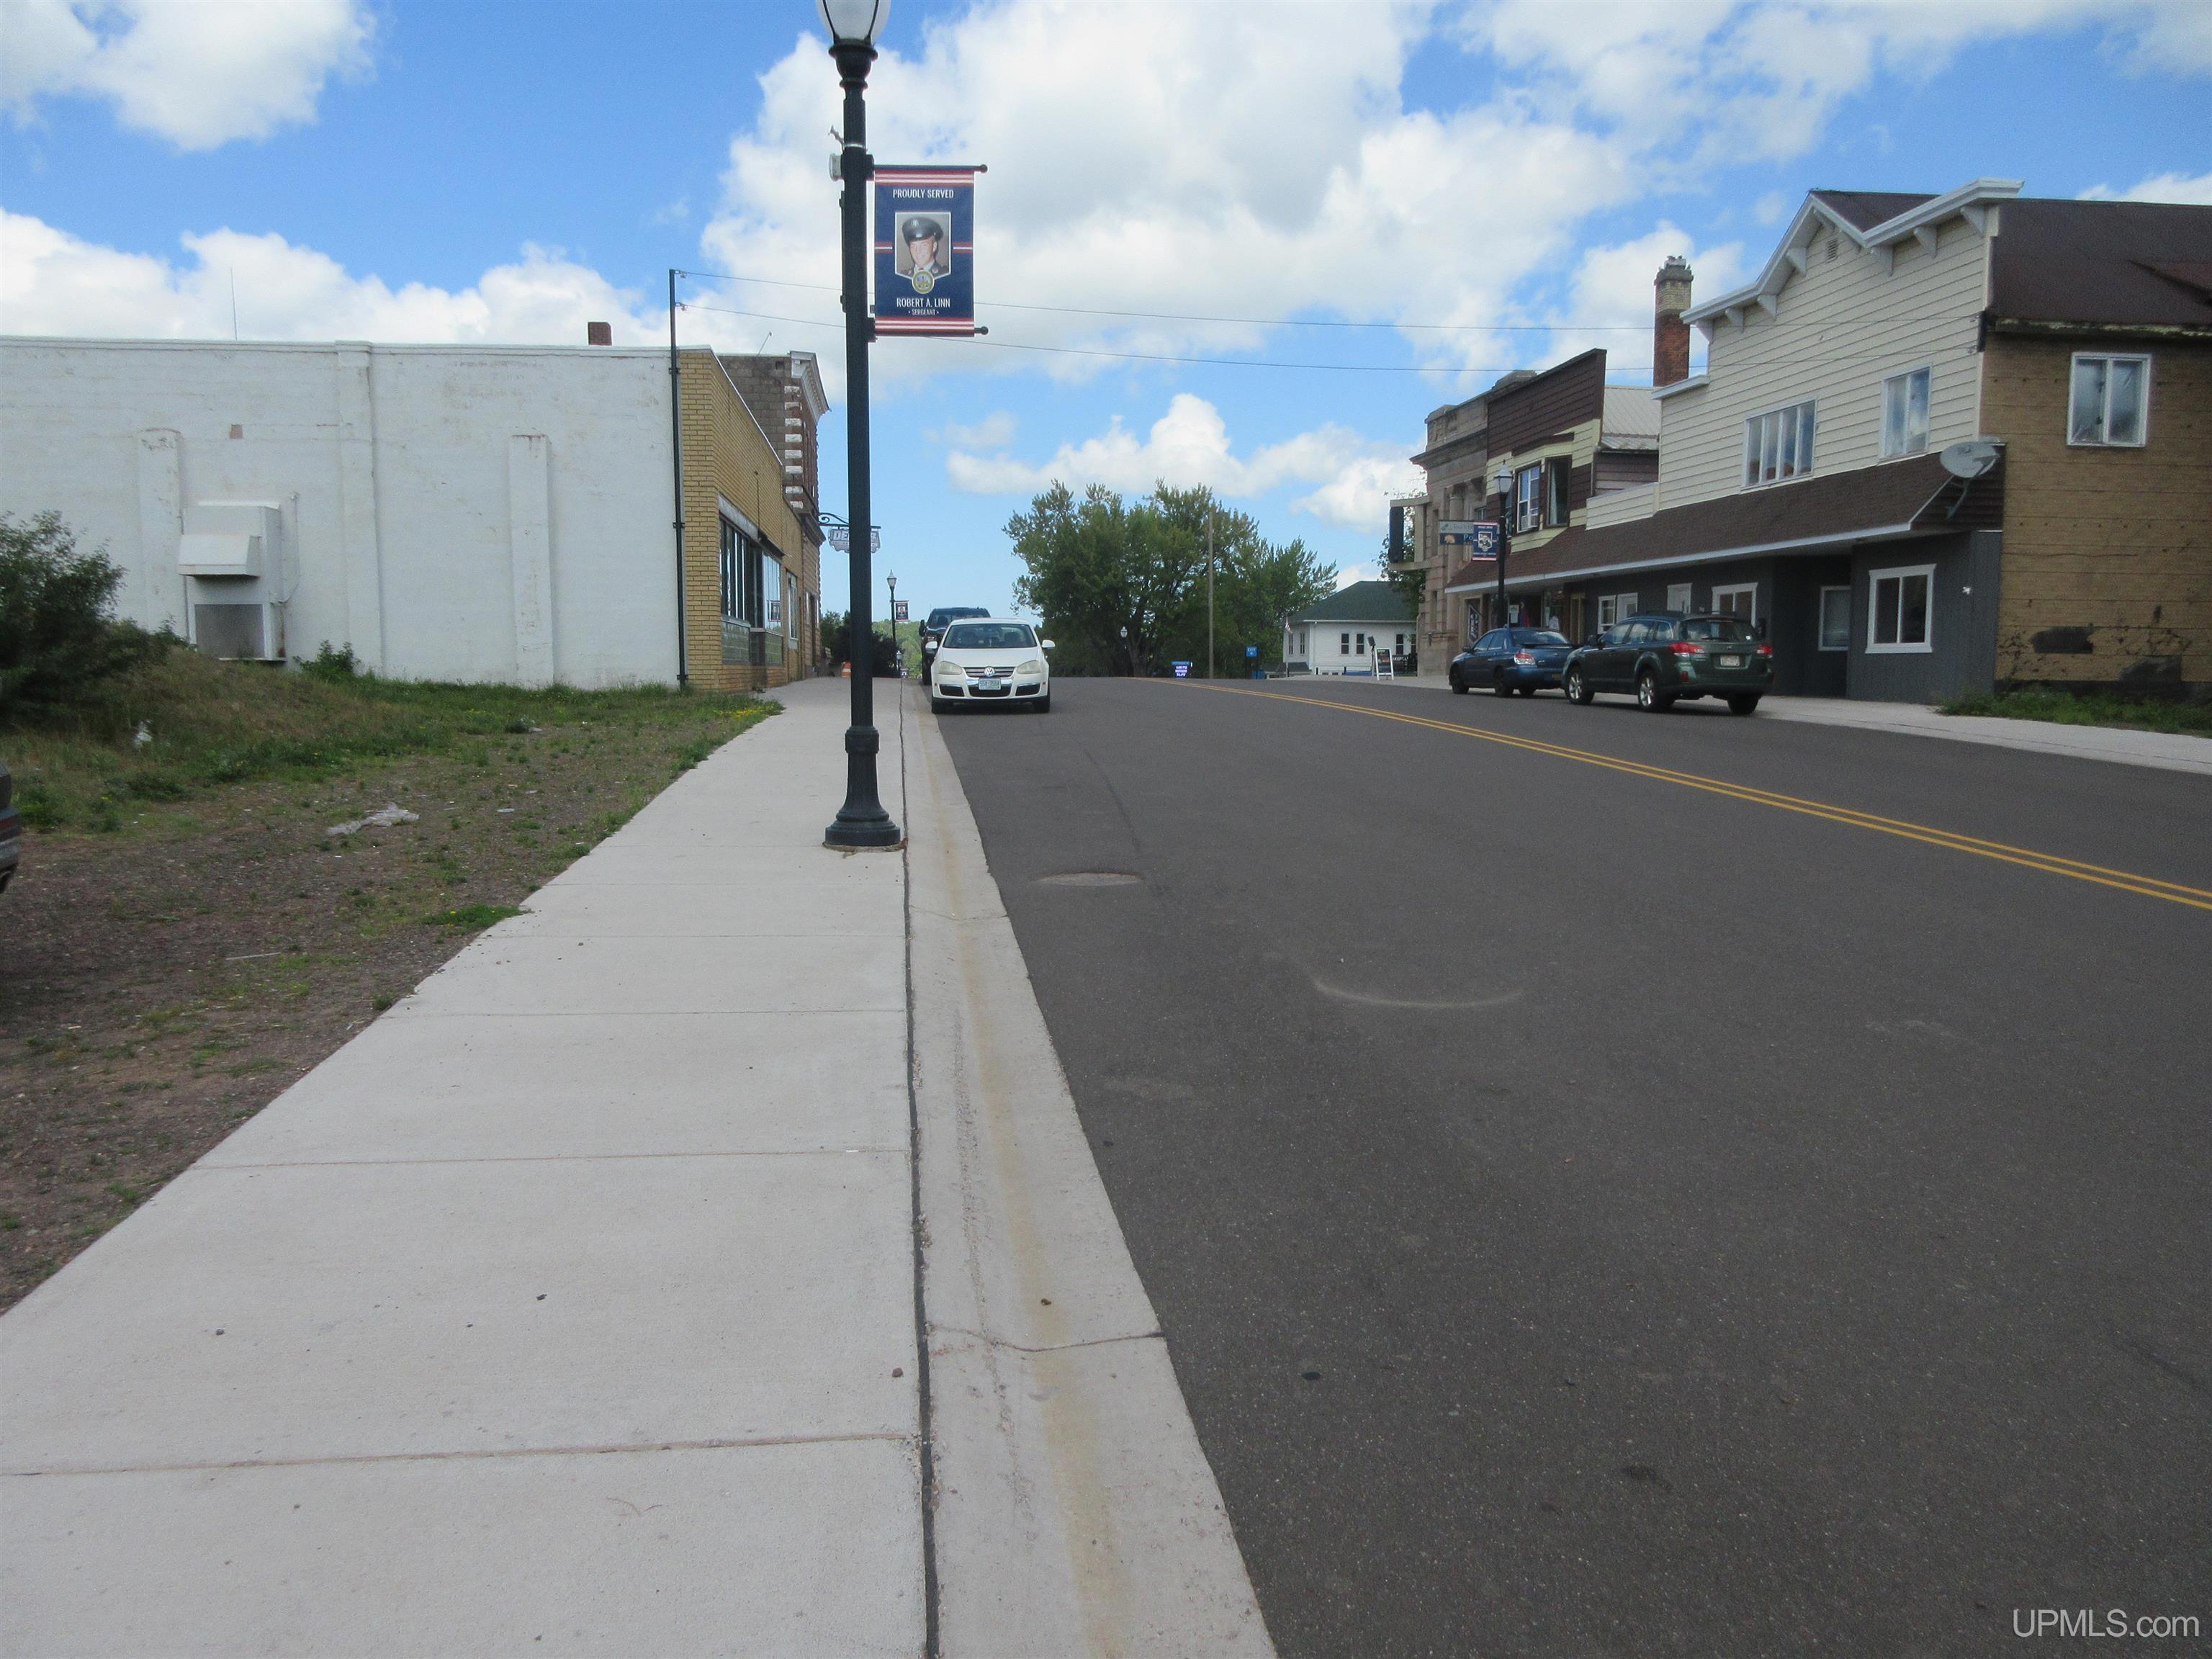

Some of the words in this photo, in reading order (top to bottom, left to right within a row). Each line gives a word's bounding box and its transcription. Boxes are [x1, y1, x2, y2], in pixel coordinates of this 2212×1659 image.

[893, 189, 925, 199] PROUDLY
[927, 189, 954, 199] SERVED
[896, 297, 924, 307] ROBERT
[926, 298, 932, 307] A.
[934, 298, 950, 308] LINN
